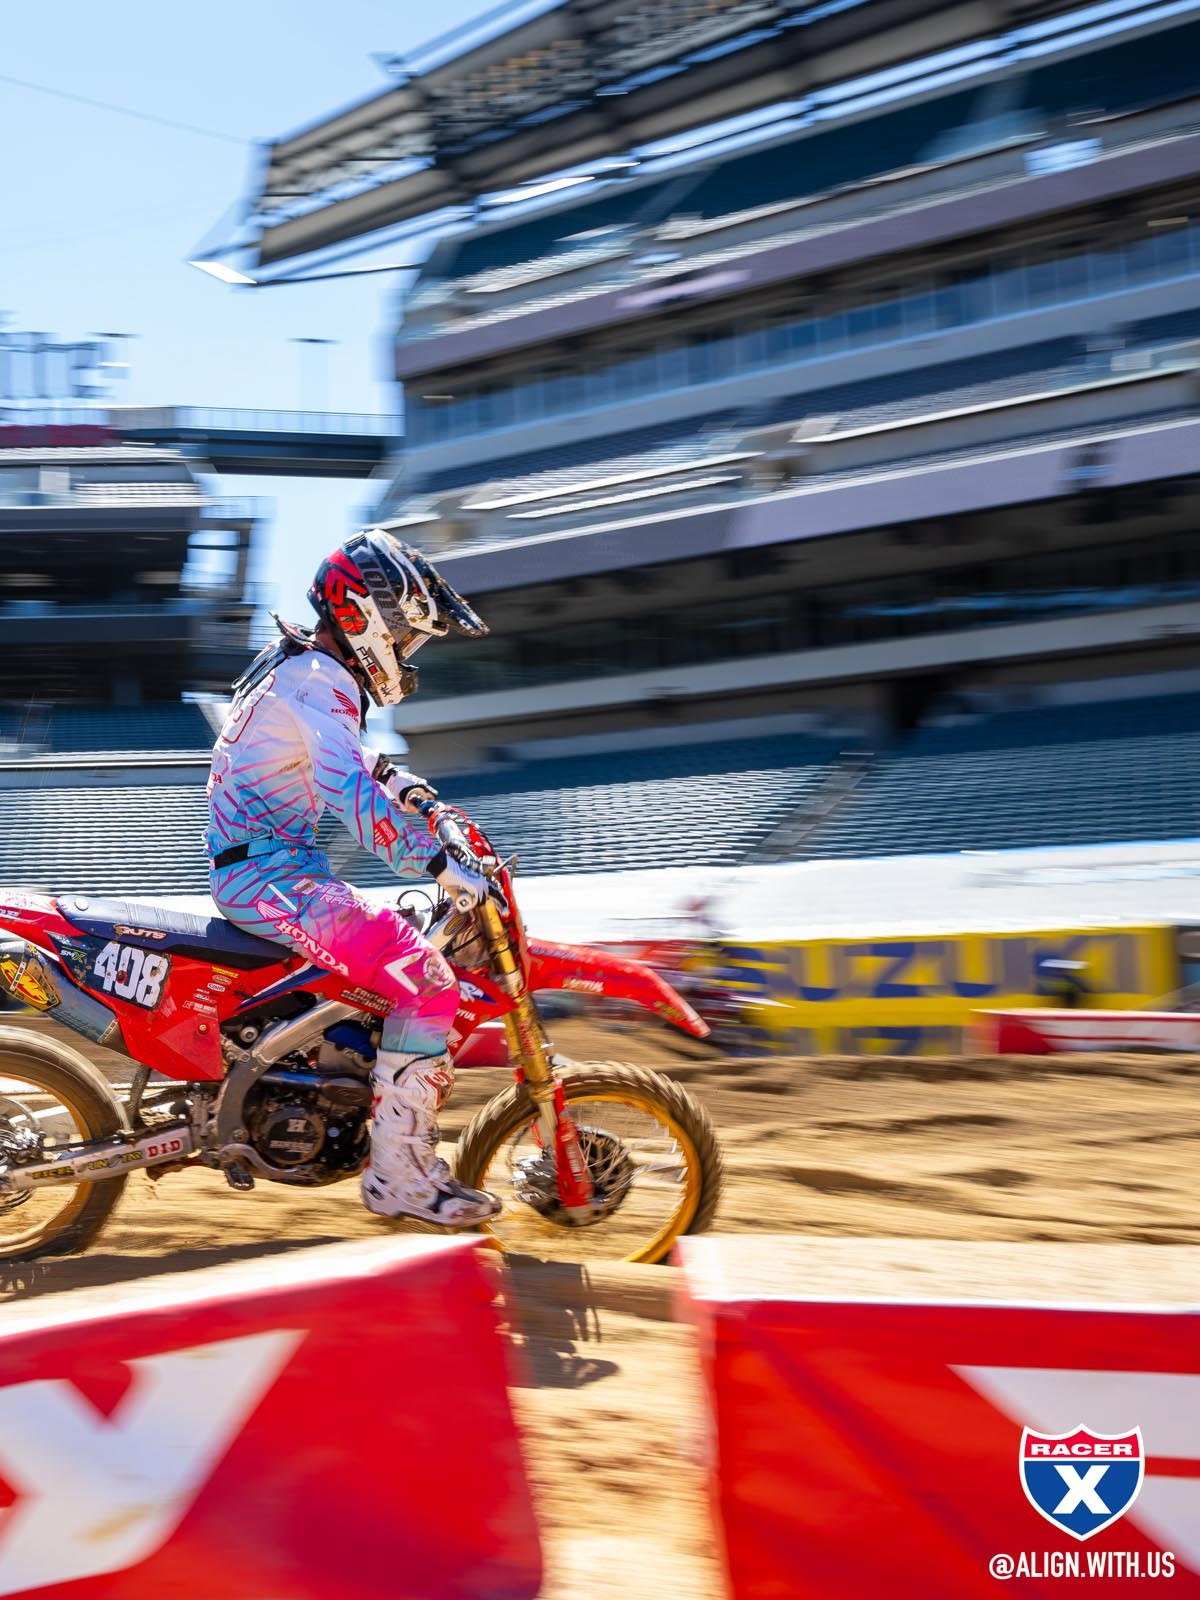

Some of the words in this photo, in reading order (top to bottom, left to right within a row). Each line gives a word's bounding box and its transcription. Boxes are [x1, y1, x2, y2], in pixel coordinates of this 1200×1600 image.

[113, 924, 167, 940] GUTS
[279, 919, 350, 977] HONDA
[93, 940, 170, 1008] 408
